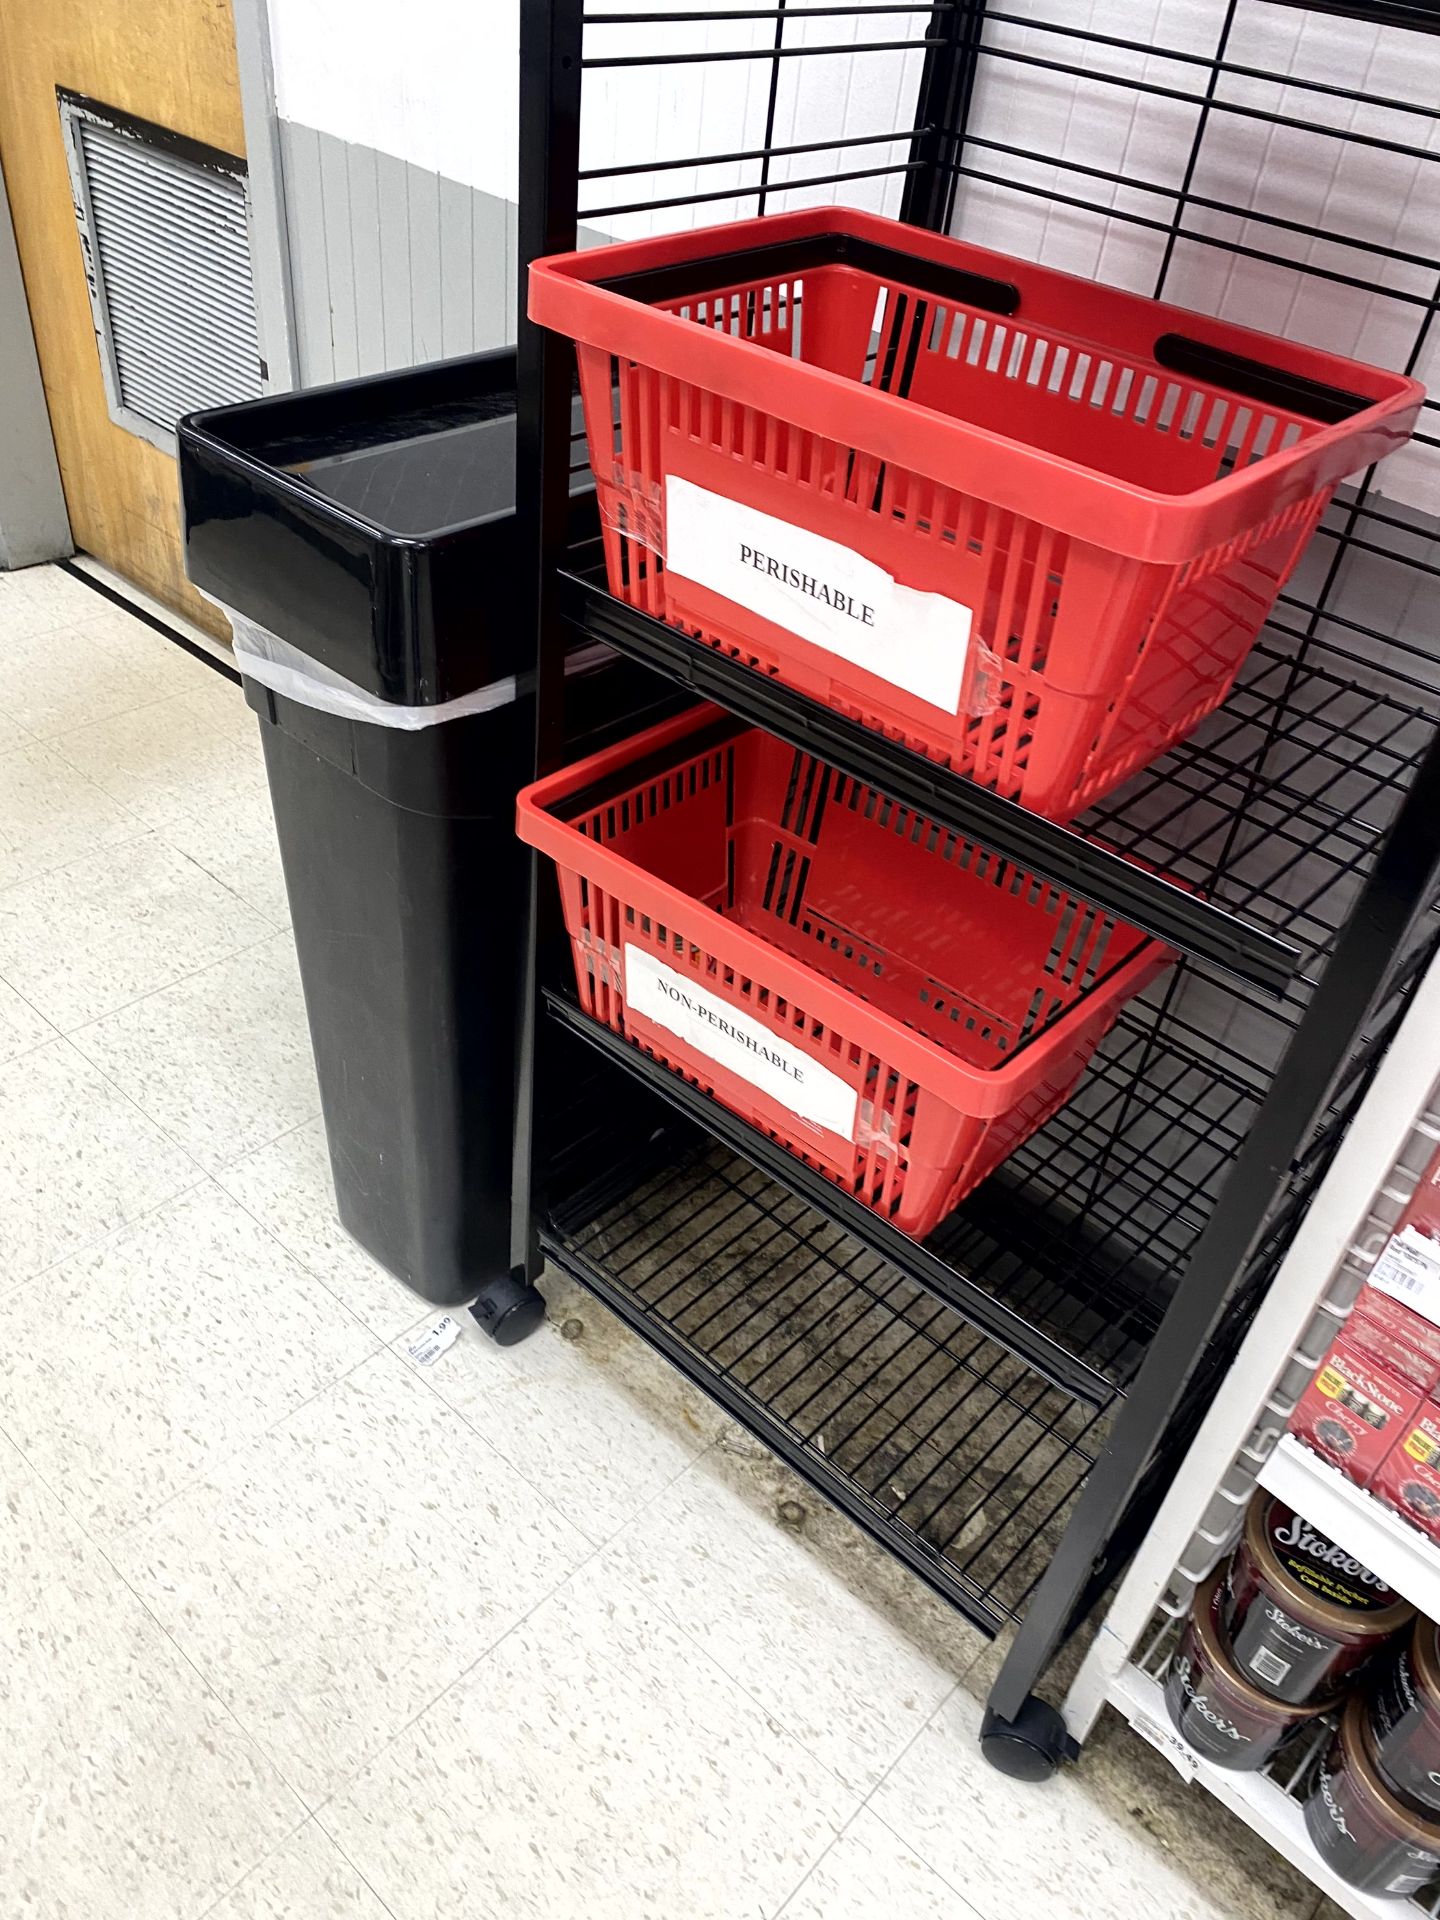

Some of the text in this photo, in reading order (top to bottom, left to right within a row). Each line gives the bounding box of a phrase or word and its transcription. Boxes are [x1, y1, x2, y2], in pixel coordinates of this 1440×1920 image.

[739, 542, 875, 627] PERISHABLE
[656, 977, 805, 1084] NON-PERISHABLE
[1325, 1400, 1368, 1435] Cherry
[1264, 1608, 1329, 1650] Stoker's
[1173, 1656, 1252, 1742] Stoker's
